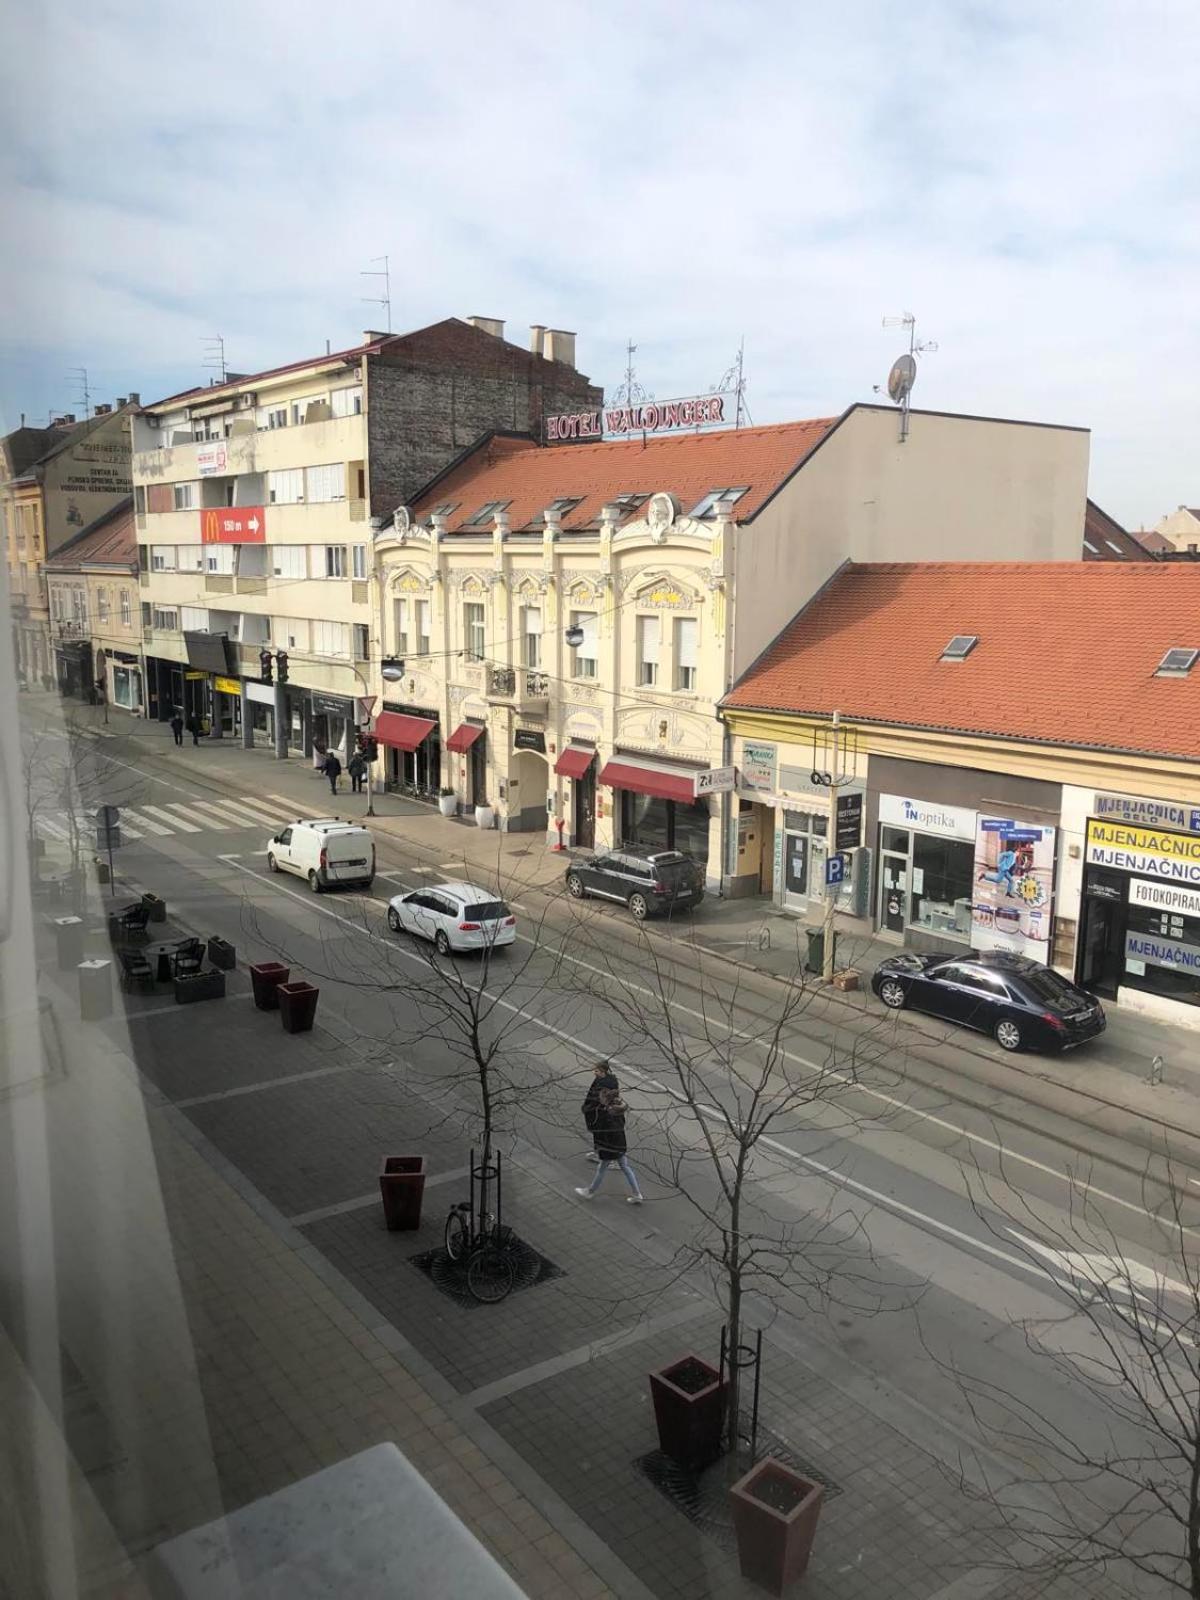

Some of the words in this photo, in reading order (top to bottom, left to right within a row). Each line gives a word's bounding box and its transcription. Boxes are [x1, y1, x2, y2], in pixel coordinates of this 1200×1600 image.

[546, 412, 602, 440] HOTEL
[605, 396, 725, 433] WALDINGER
[224, 519, 235, 532] 150
[829, 860, 841, 881] P
